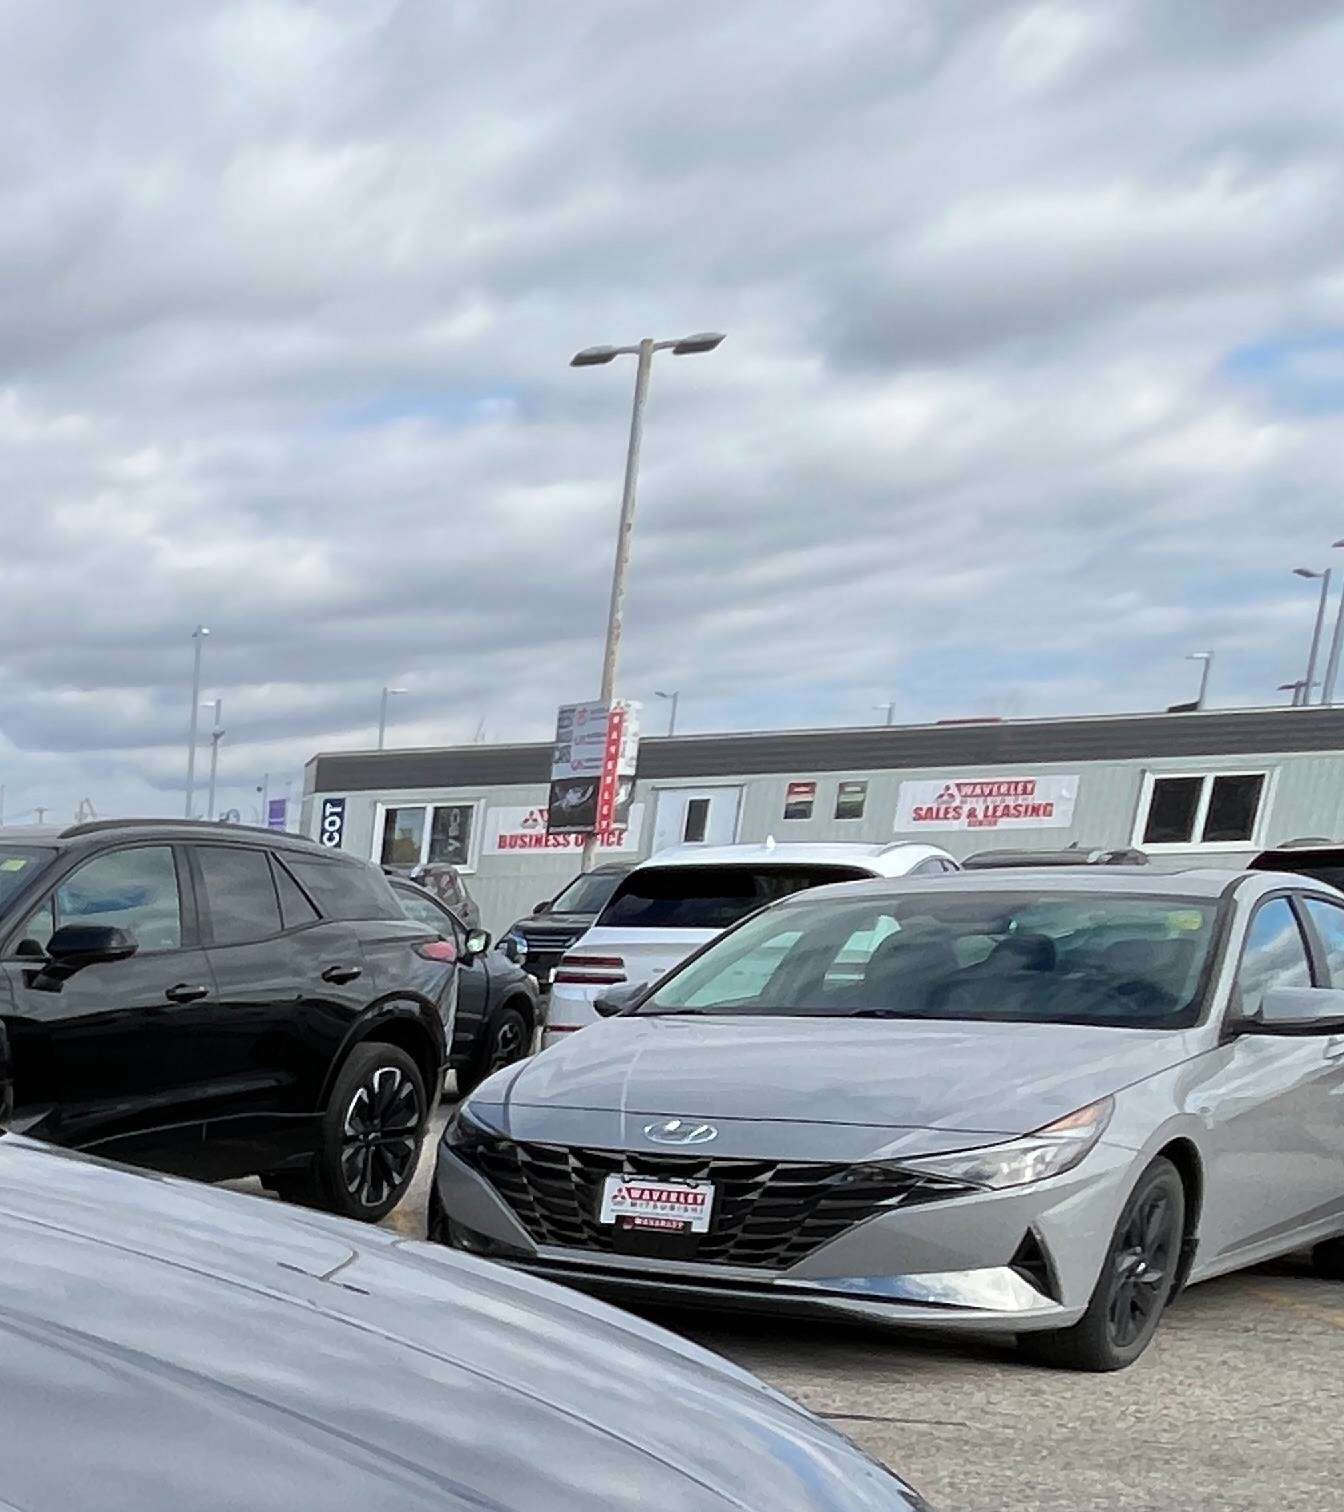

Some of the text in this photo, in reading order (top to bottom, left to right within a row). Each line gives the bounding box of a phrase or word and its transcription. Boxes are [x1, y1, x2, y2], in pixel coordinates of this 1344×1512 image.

[961, 781, 1035, 796] WAVERLEY
[913, 803, 1054, 821] SALES & LEASING
[497, 833, 570, 849] BUSINESS
[630, 1188, 705, 1204] WAVERLEY
